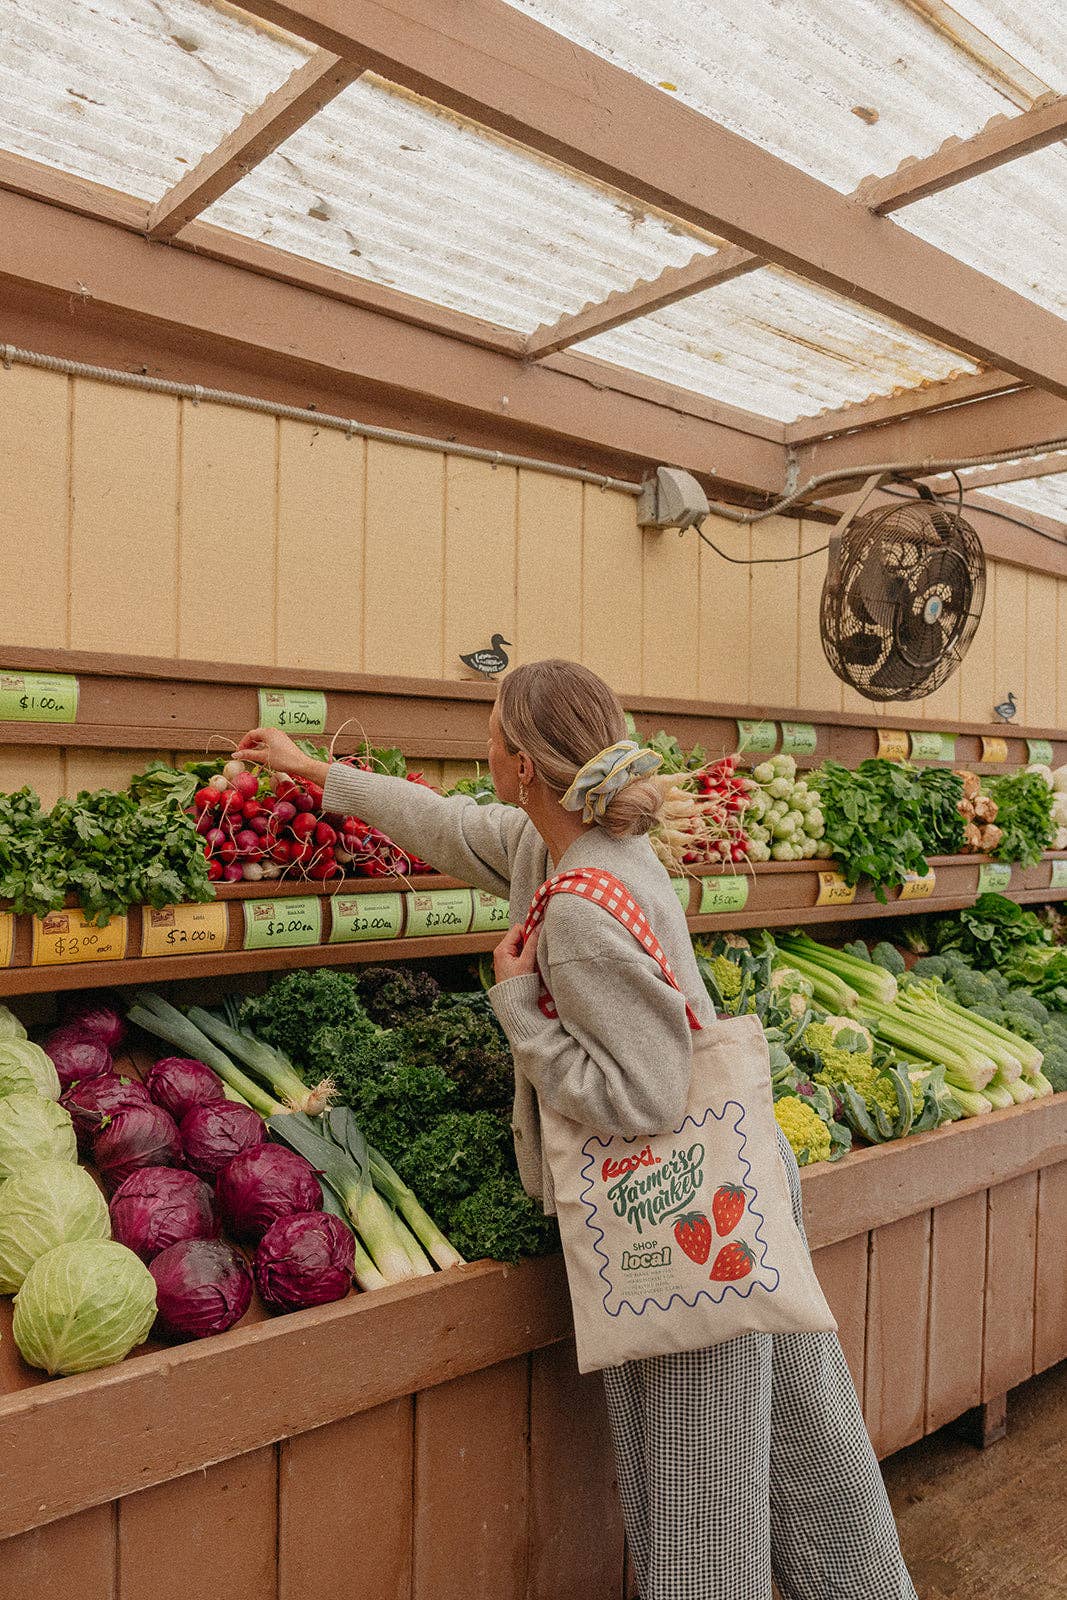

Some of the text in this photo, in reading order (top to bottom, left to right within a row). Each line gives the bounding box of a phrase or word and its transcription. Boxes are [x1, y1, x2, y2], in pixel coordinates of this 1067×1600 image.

[607, 1148, 690, 1217] Farmer's
[627, 1160, 704, 1234] Market
[621, 1246, 671, 1270] local
[632, 1240, 658, 1251] SHOP
